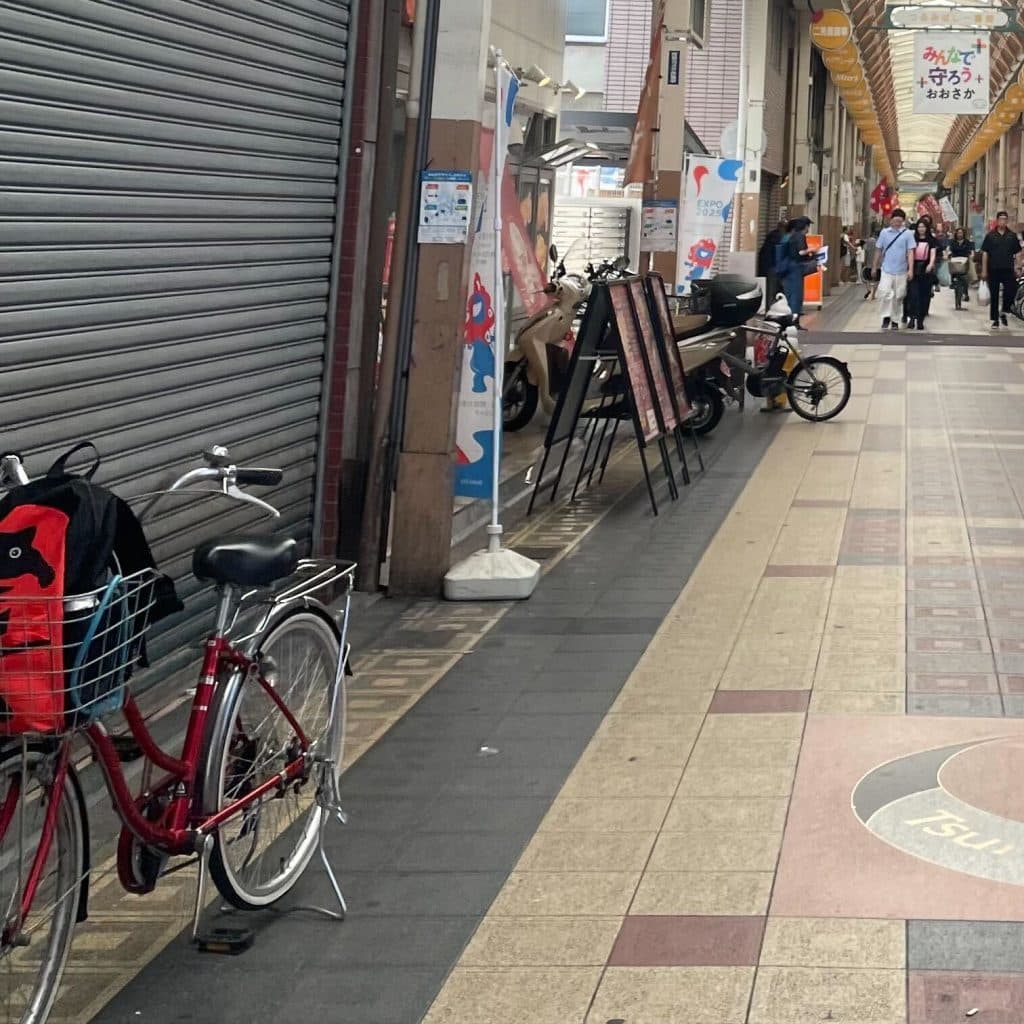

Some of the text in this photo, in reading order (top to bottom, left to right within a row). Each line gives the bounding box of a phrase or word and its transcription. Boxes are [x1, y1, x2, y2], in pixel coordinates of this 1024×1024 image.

[923, 46, 976, 66] みんなで
[928, 67, 972, 86] 守ろう
[926, 87, 975, 100] おおさか
[697, 199, 723, 207] EXPO
[696, 208, 721, 216] 2025
